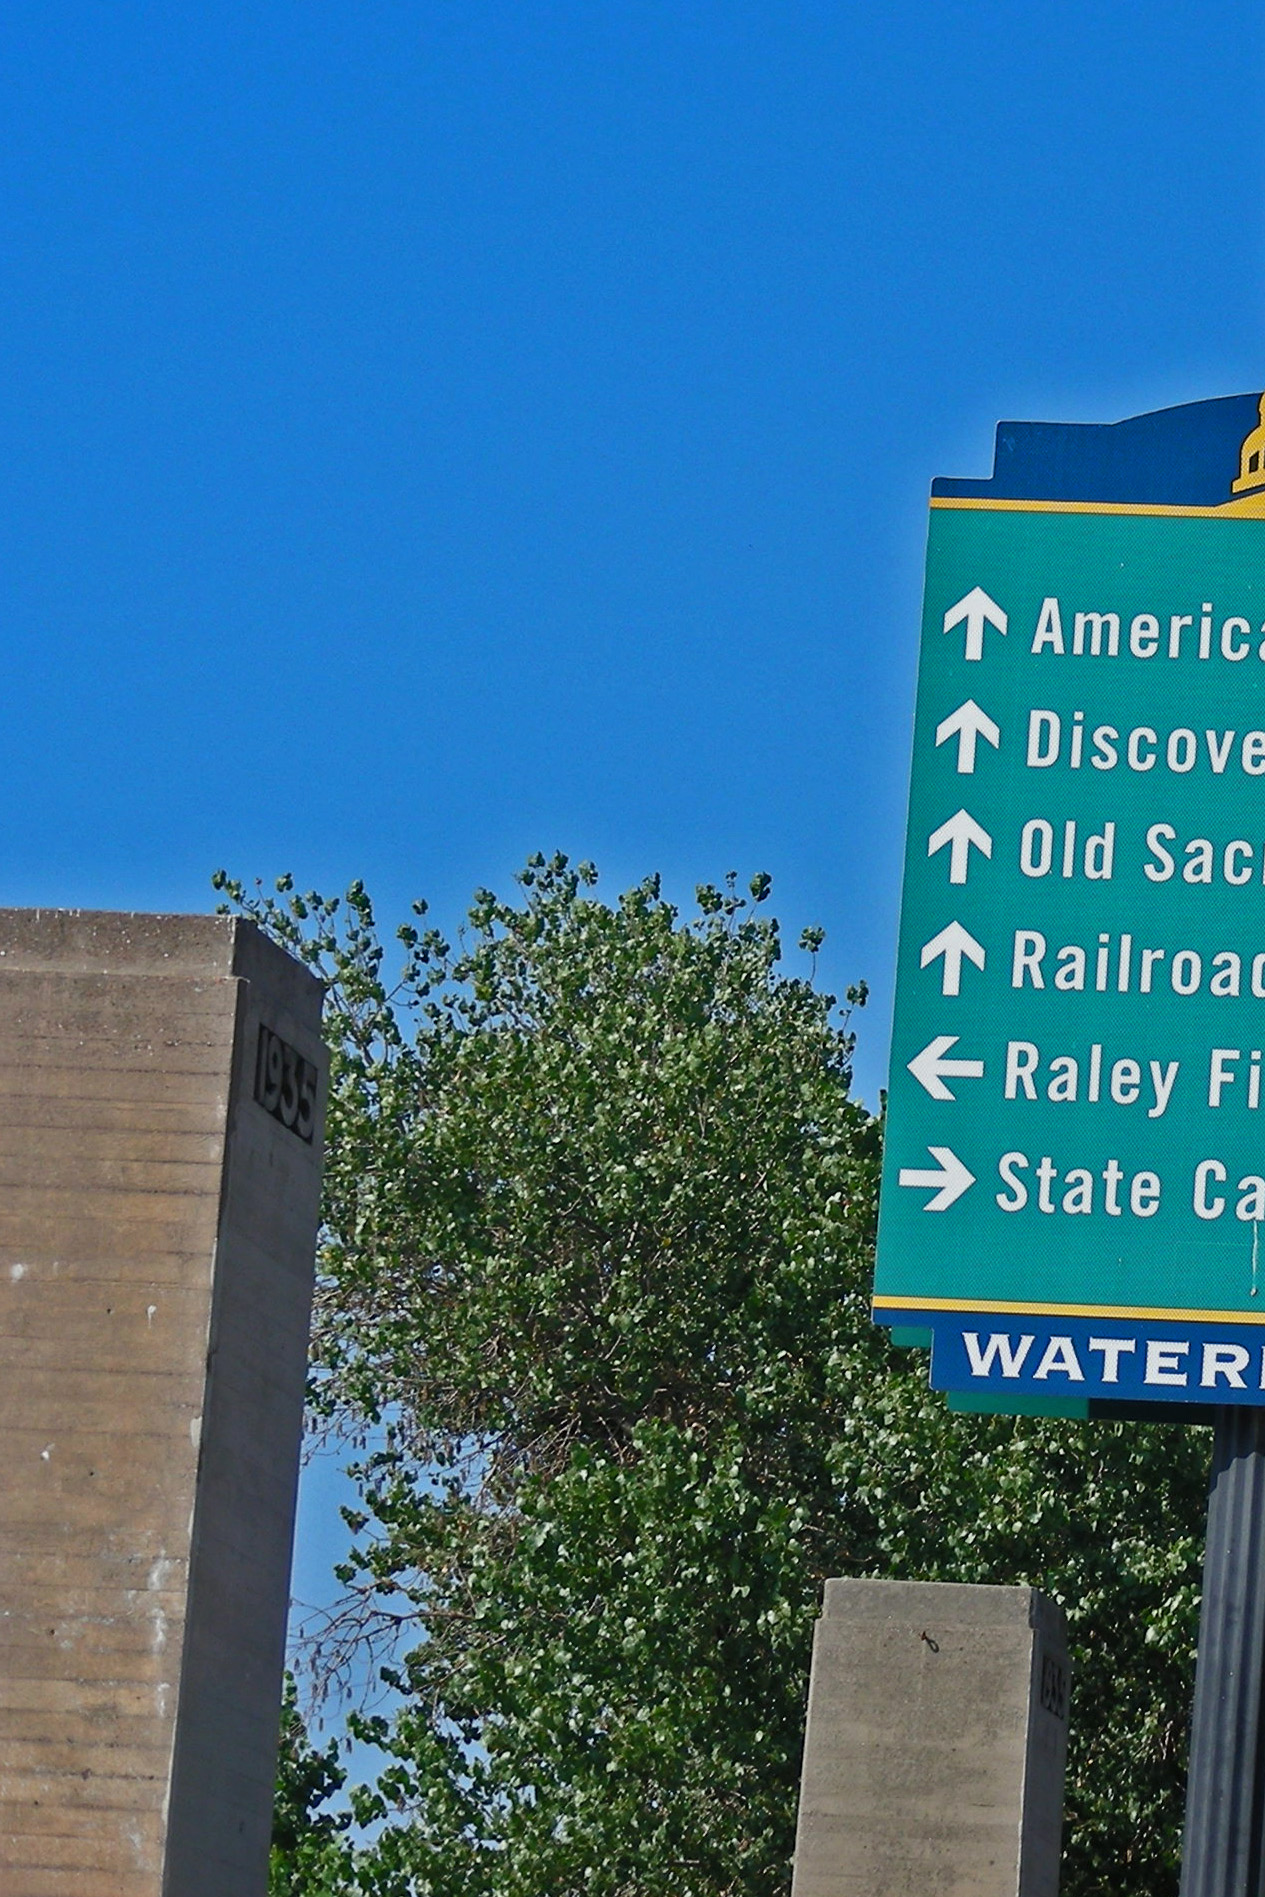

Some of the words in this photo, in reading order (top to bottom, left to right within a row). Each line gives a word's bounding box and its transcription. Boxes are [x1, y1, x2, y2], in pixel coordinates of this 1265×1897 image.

[1020, 818, 1115, 880] Old
[257, 1026, 317, 1141] 1935
[1004, 1041, 1180, 1118] Raley
[996, 1151, 1161, 1217] State
